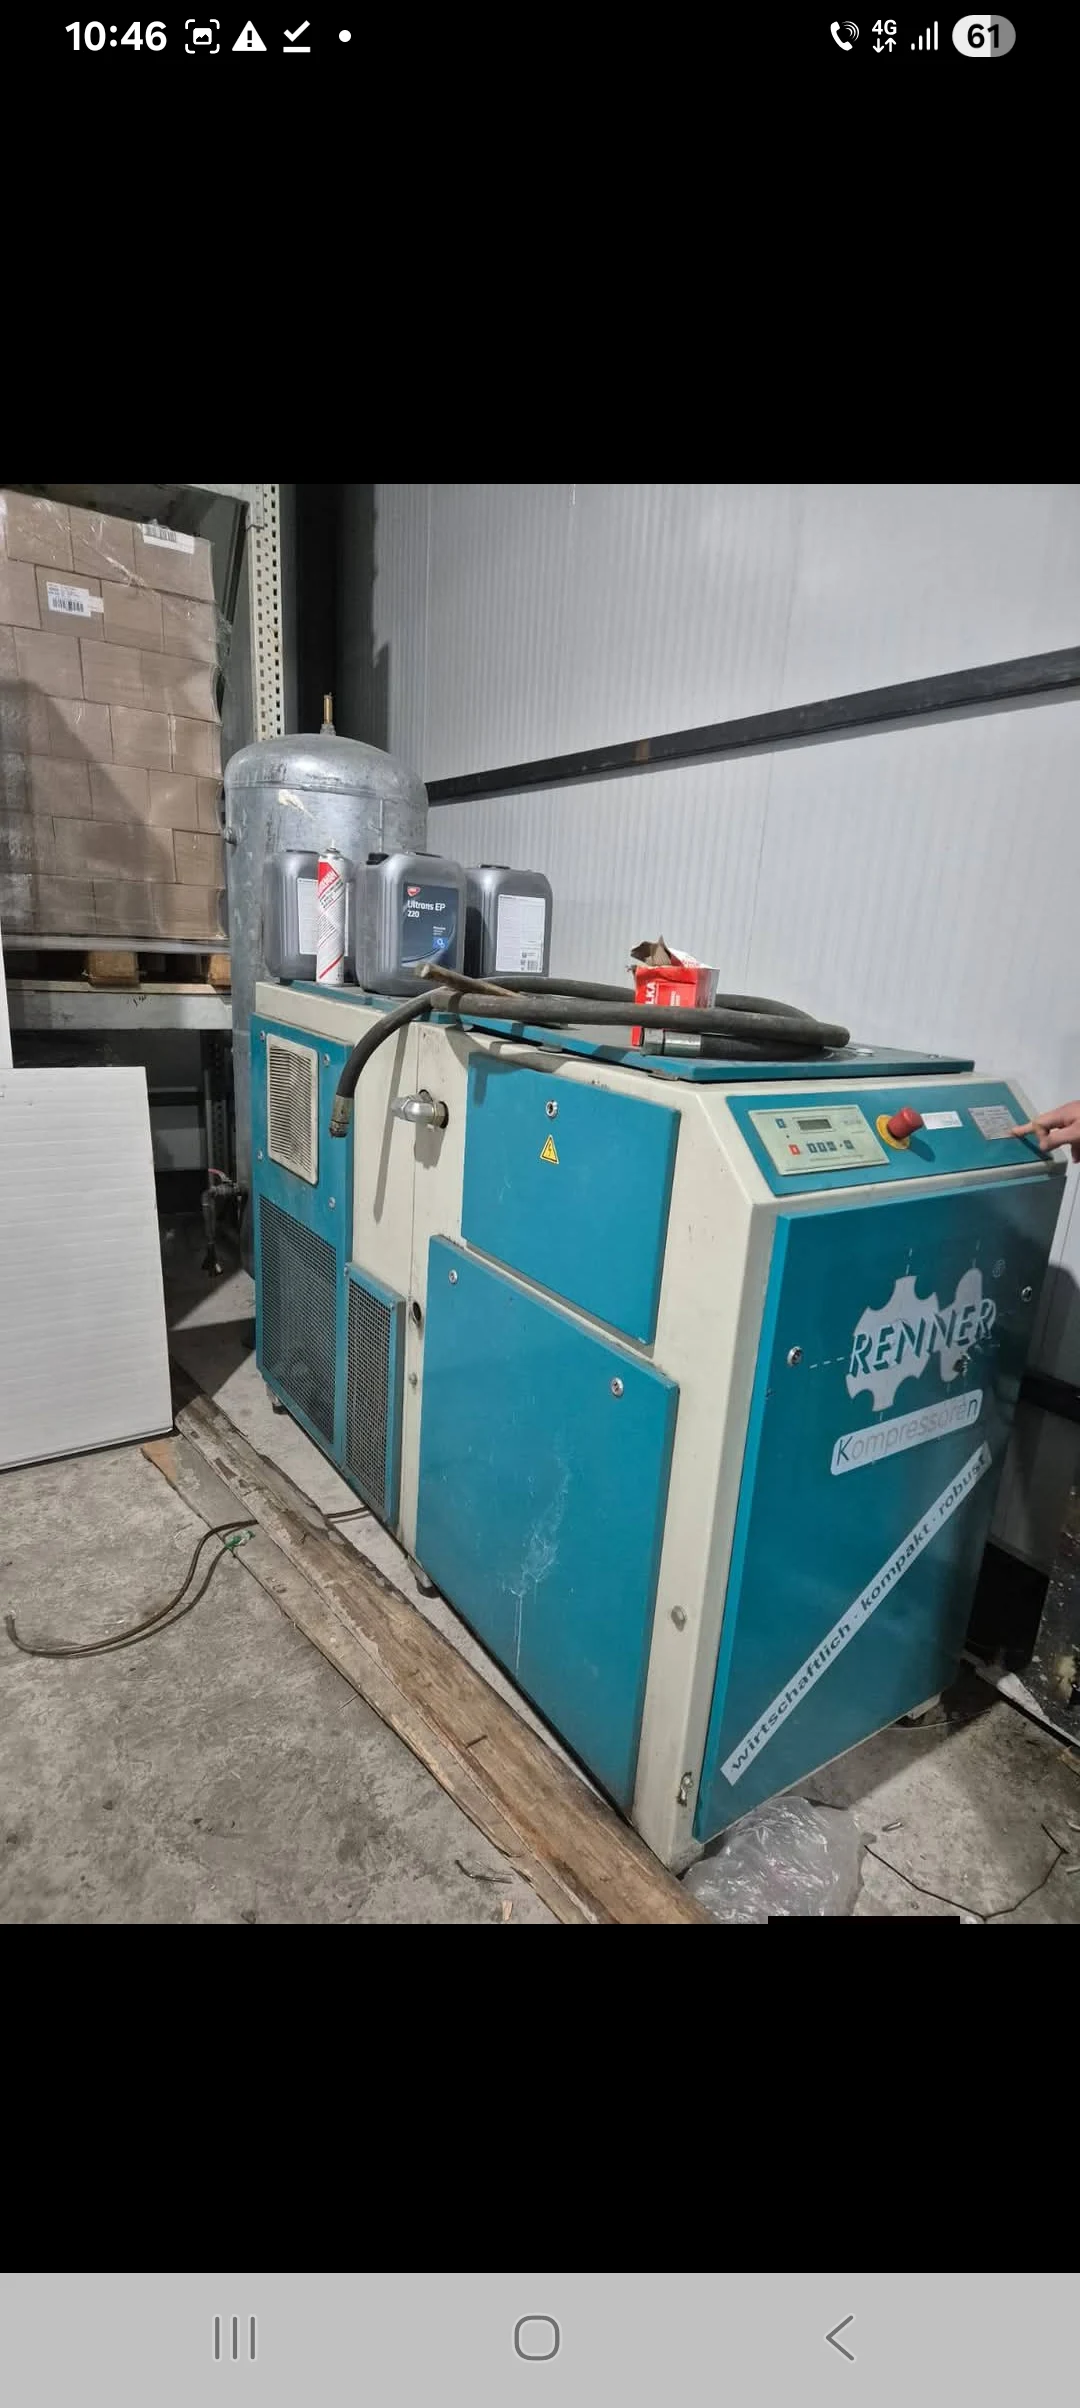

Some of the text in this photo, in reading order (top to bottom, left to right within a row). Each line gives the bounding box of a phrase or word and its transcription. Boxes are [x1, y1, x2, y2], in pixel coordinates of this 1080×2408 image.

[407, 909, 420, 918] 220
[435, 902, 446, 912] EP
[850, 1298, 997, 1377] RENNER
[836, 1398, 978, 1467] Kompressoren
[730, 1453, 989, 1773] wirtschaftlich kompakt robust
